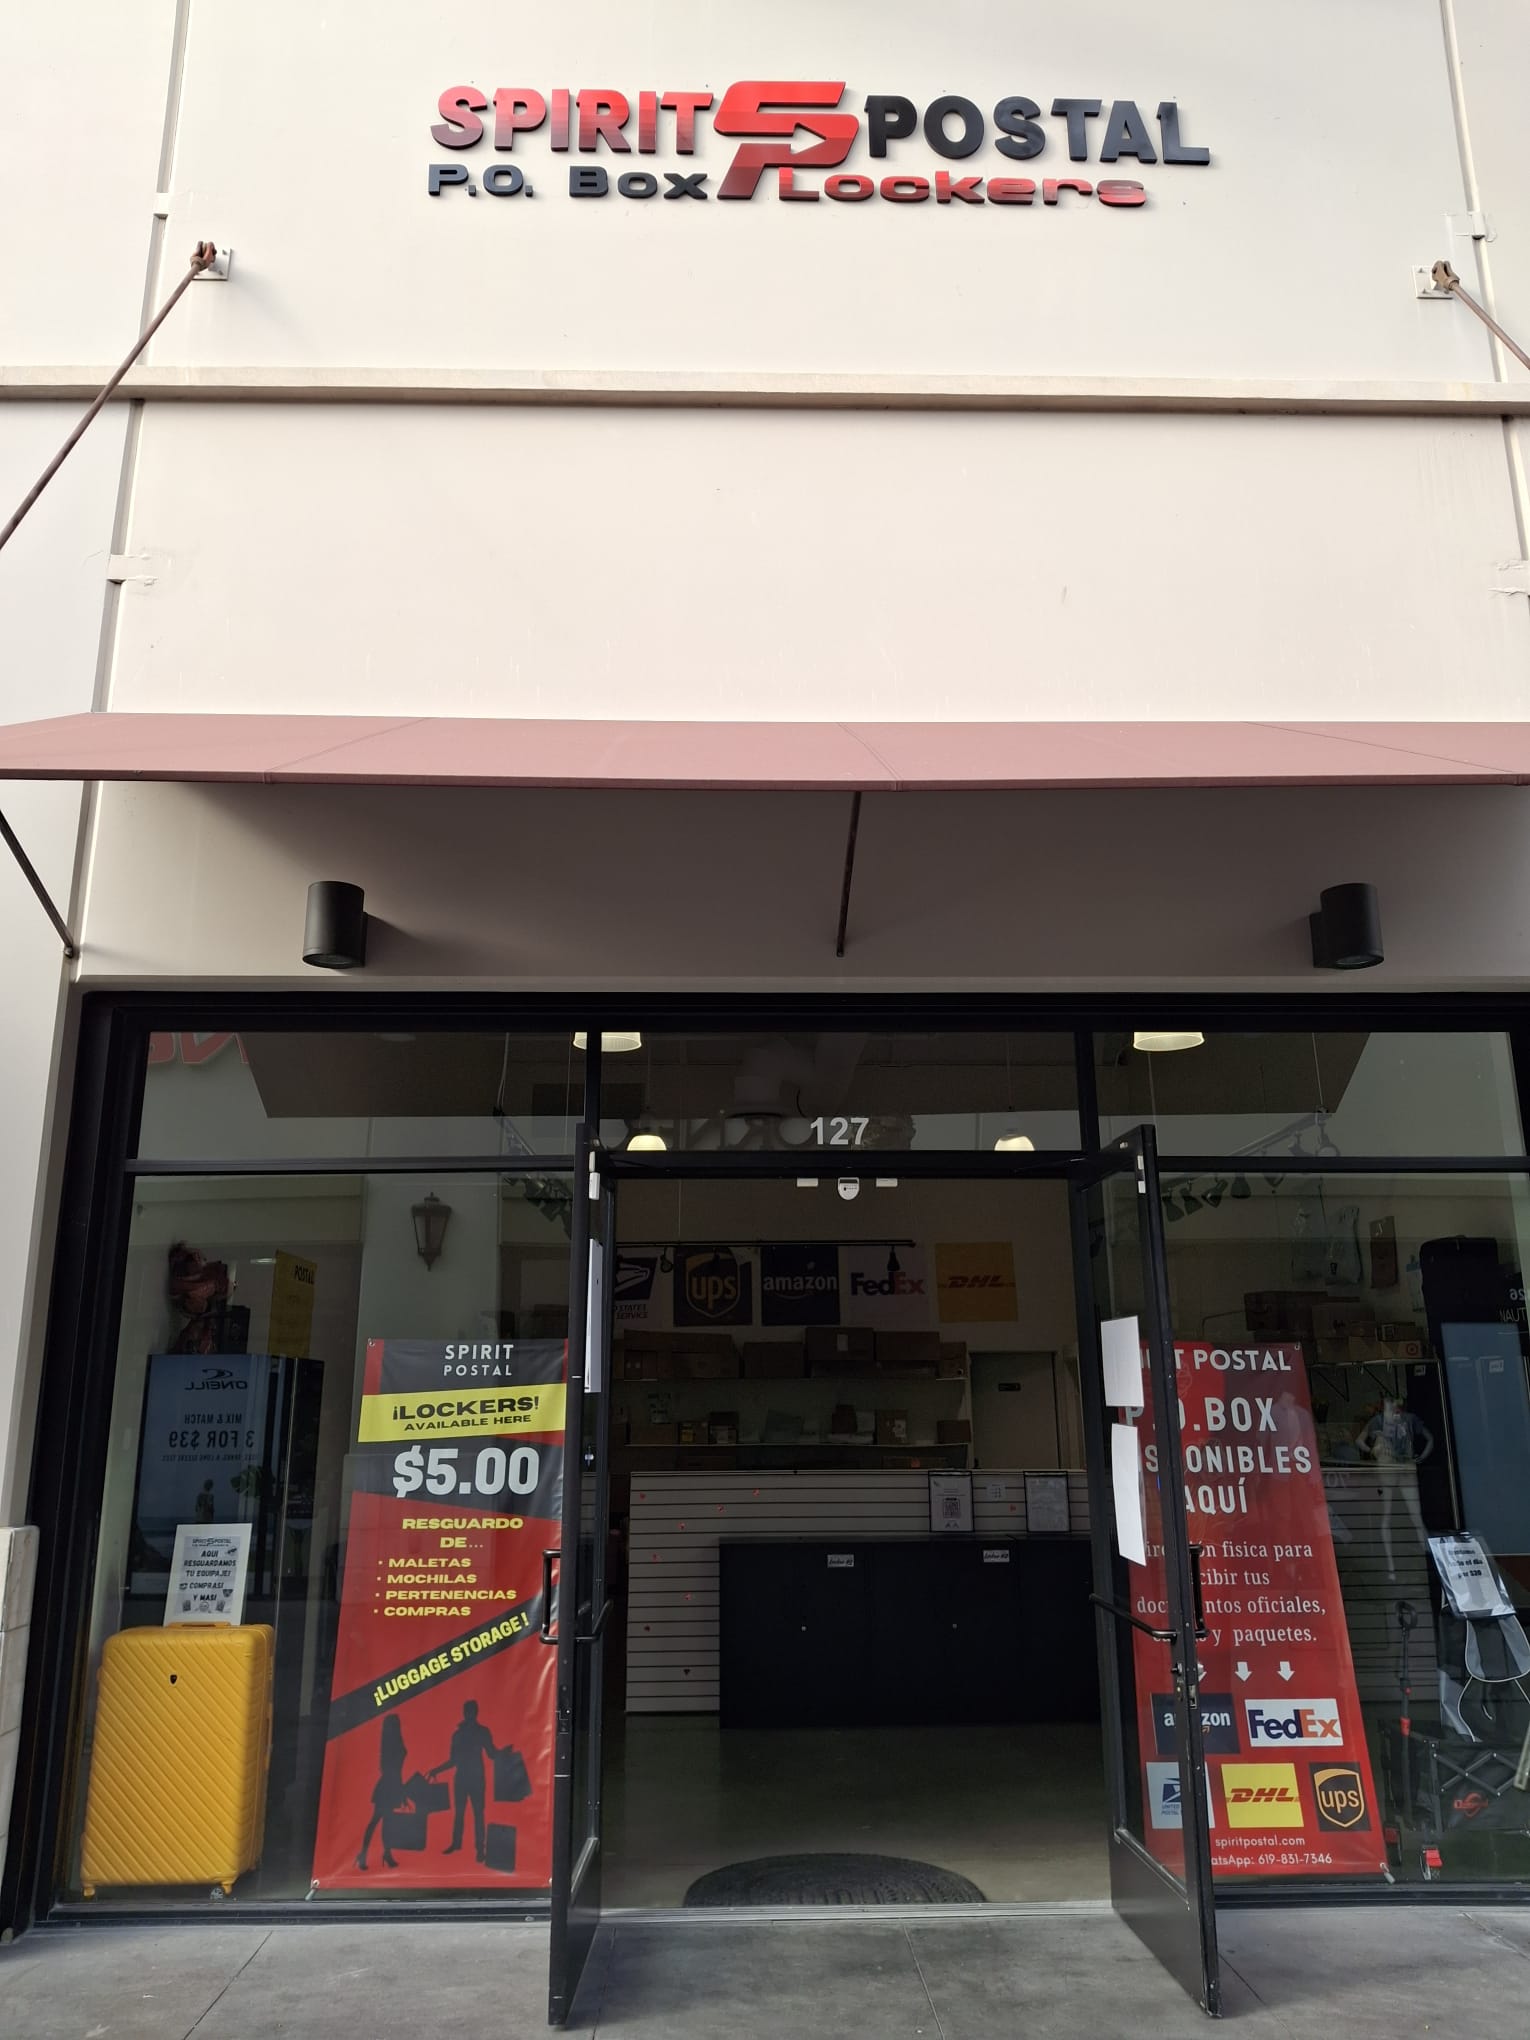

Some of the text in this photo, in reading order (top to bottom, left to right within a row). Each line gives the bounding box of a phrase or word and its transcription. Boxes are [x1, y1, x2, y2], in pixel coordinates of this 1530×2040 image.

[430, 85, 714, 155] SPIRIT
[864, 95, 1210, 165] POSTAL
[428, 164, 1147, 208] P.O. Box Lockers
[810, 1116, 869, 1145] 127
[762, 1273, 838, 1292] amazon
[851, 1271, 926, 1297] FedEx
[947, 1275, 1005, 1289] DHL
[691, 1274, 737, 1311] ups
[444, 1344, 515, 1360] SPIRIT
[1194, 1349, 1291, 1371] POSTAL
[443, 1364, 513, 1377] POSTAL
[404, 1414, 532, 1432] AVAILABLE HERE
[392, 1445, 540, 1498] $5.00
[402, 1517, 524, 1530] RESGUARDO
[1273, 1543, 1313, 1562] para
[388, 1558, 472, 1568] MALETAS
[387, 1574, 477, 1584] MOCHILAS
[1243, 1570, 1270, 1585] tus
[385, 1590, 517, 1600] PERTENENCIAS
[384, 1606, 471, 1616] COMPRAS
[1247, 1597, 1326, 1616] oficiales,
[1211, 1627, 1318, 1647] y paquetes.
[1247, 1709, 1341, 1739] FedEx
[1229, 1787, 1360, 1815] DHL ups
[1215, 1834, 1306, 1849] spiritpostal.com
[1258, 1853, 1333, 1866] 619-831-7346
